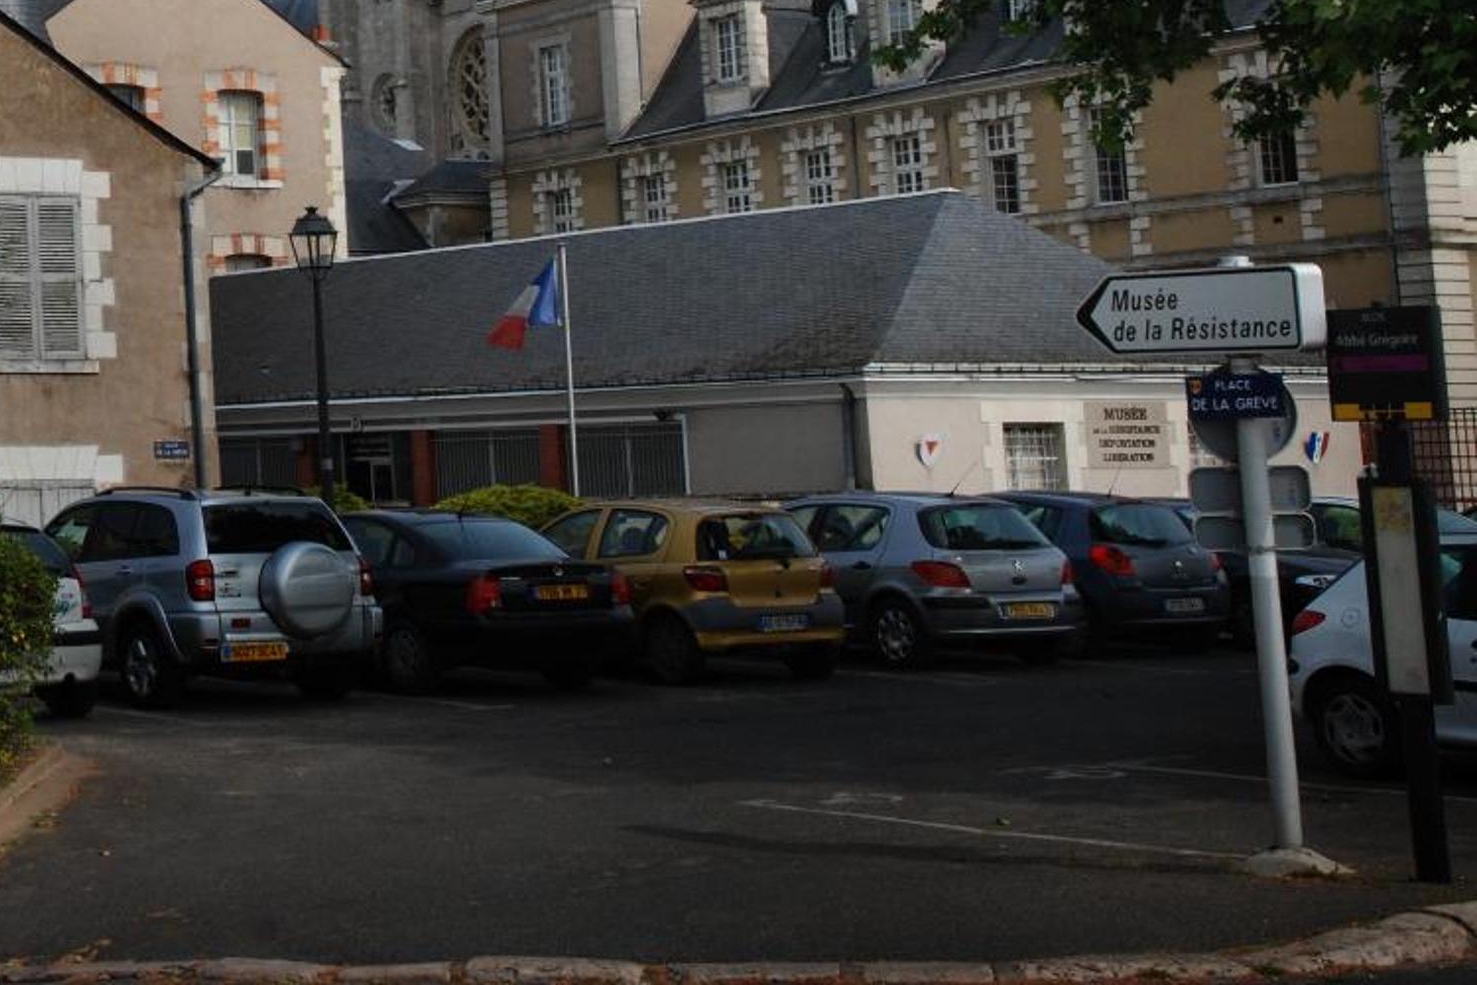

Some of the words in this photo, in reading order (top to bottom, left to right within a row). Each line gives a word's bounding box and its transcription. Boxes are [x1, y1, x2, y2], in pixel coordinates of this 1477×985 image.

[1111, 288, 1178, 312] Musée
[1114, 321, 1136, 342] de
[1145, 319, 1162, 340] la
[1171, 317, 1292, 340] Résistance
[1214, 379, 1251, 391] PLACE
[1192, 398, 1206, 411] DE
[1212, 398, 1230, 410] LA
